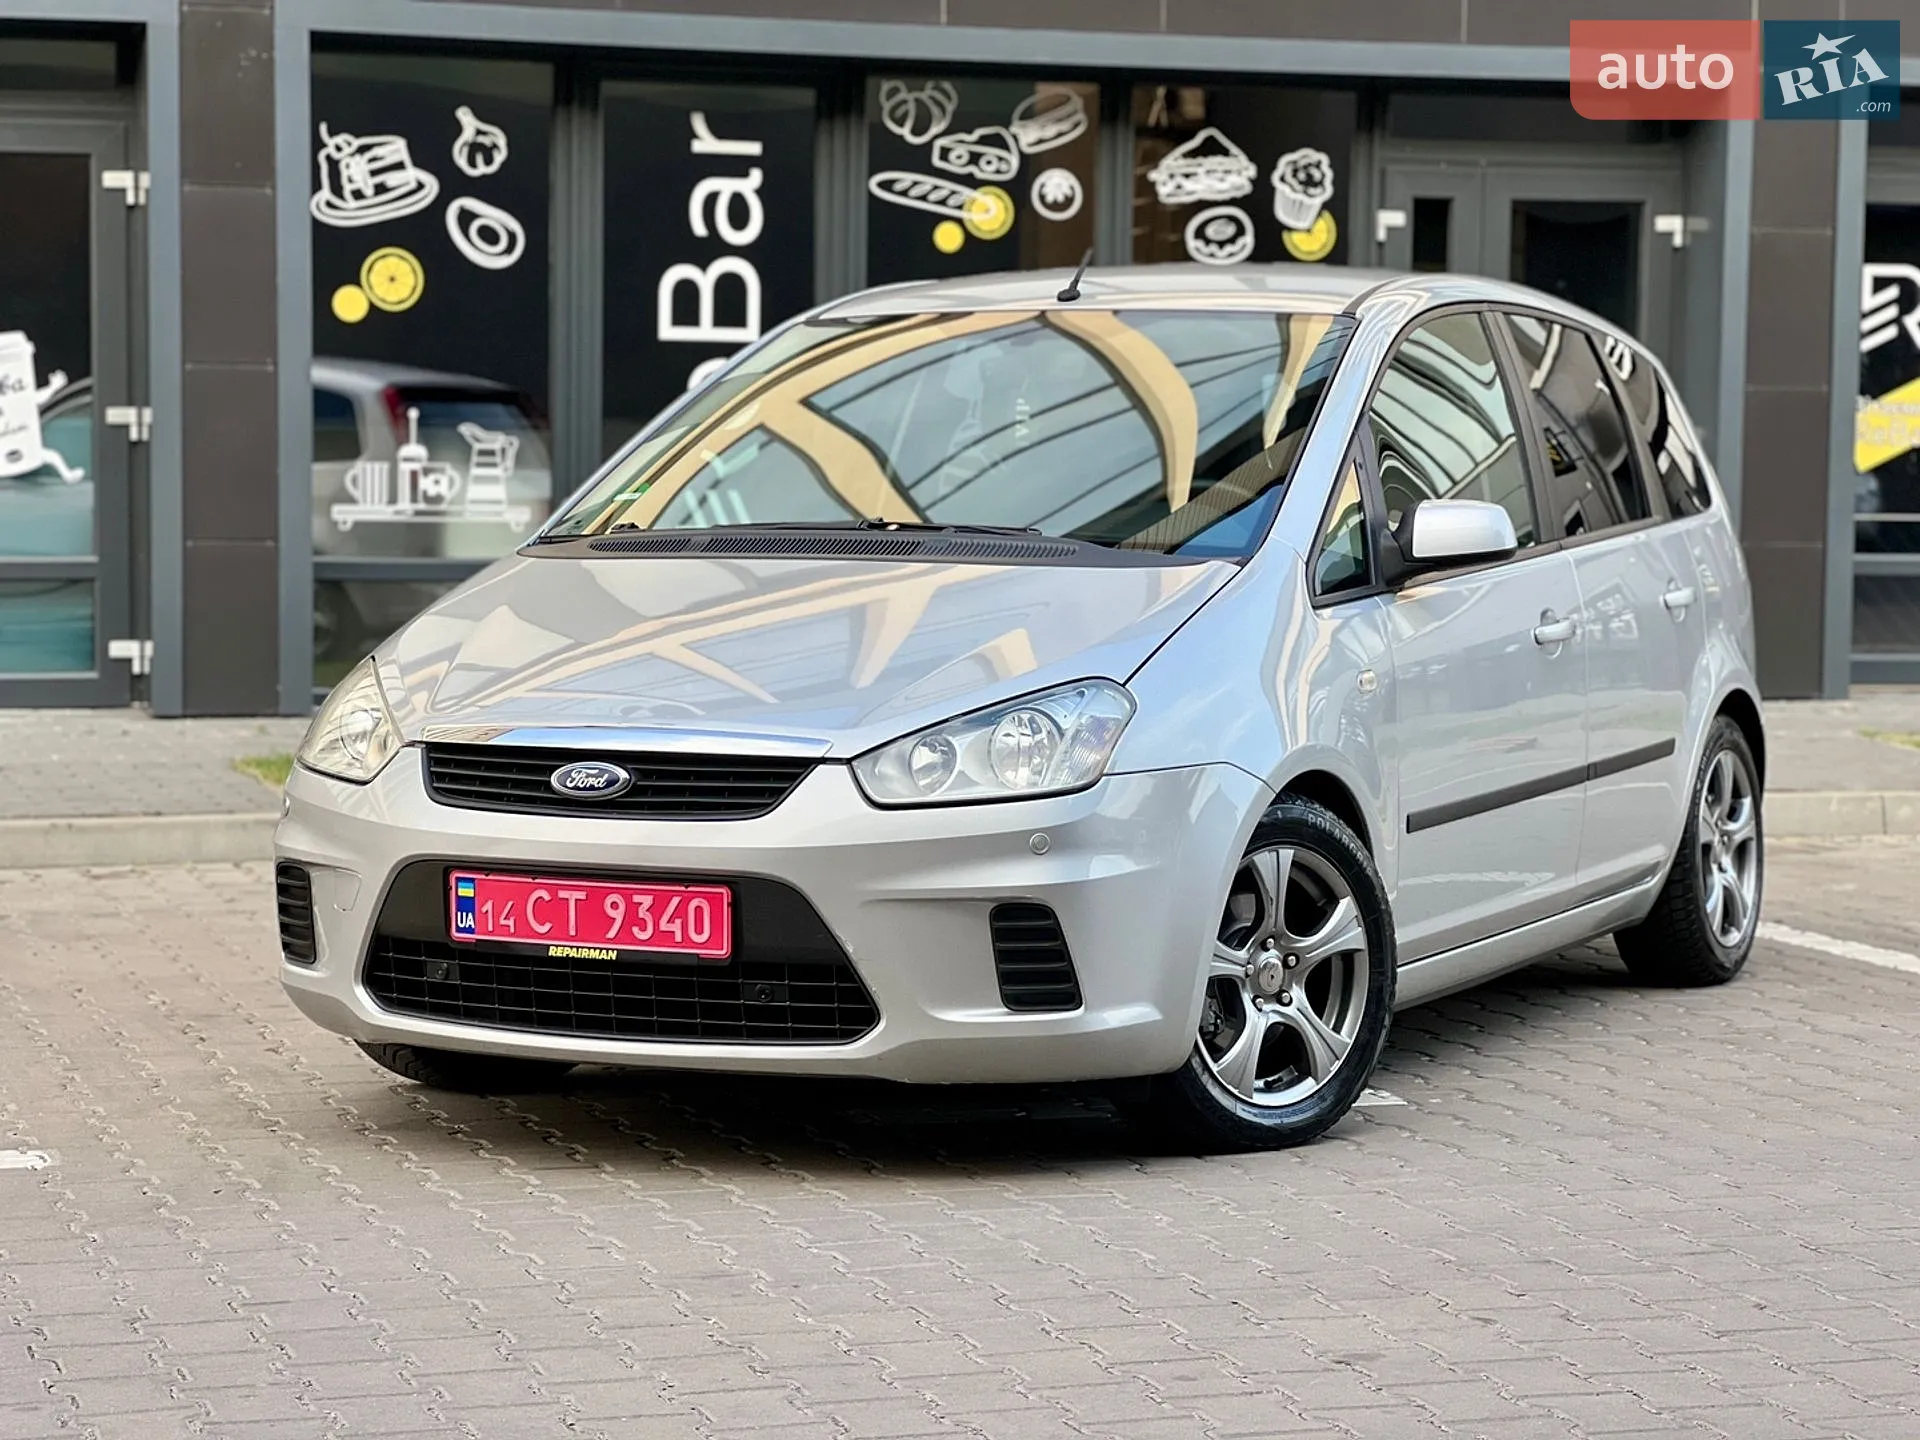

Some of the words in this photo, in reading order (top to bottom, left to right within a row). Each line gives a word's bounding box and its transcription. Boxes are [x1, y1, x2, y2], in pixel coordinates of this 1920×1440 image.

[657, 110, 765, 343] Bar
[565, 768, 609, 788] Ford
[457, 911, 476, 930] UA
[480, 899, 515, 933] 14
[526, 888, 588, 937] CT
[603, 892, 711, 944] 9340
[548, 945, 618, 961] REPAIRMAN
